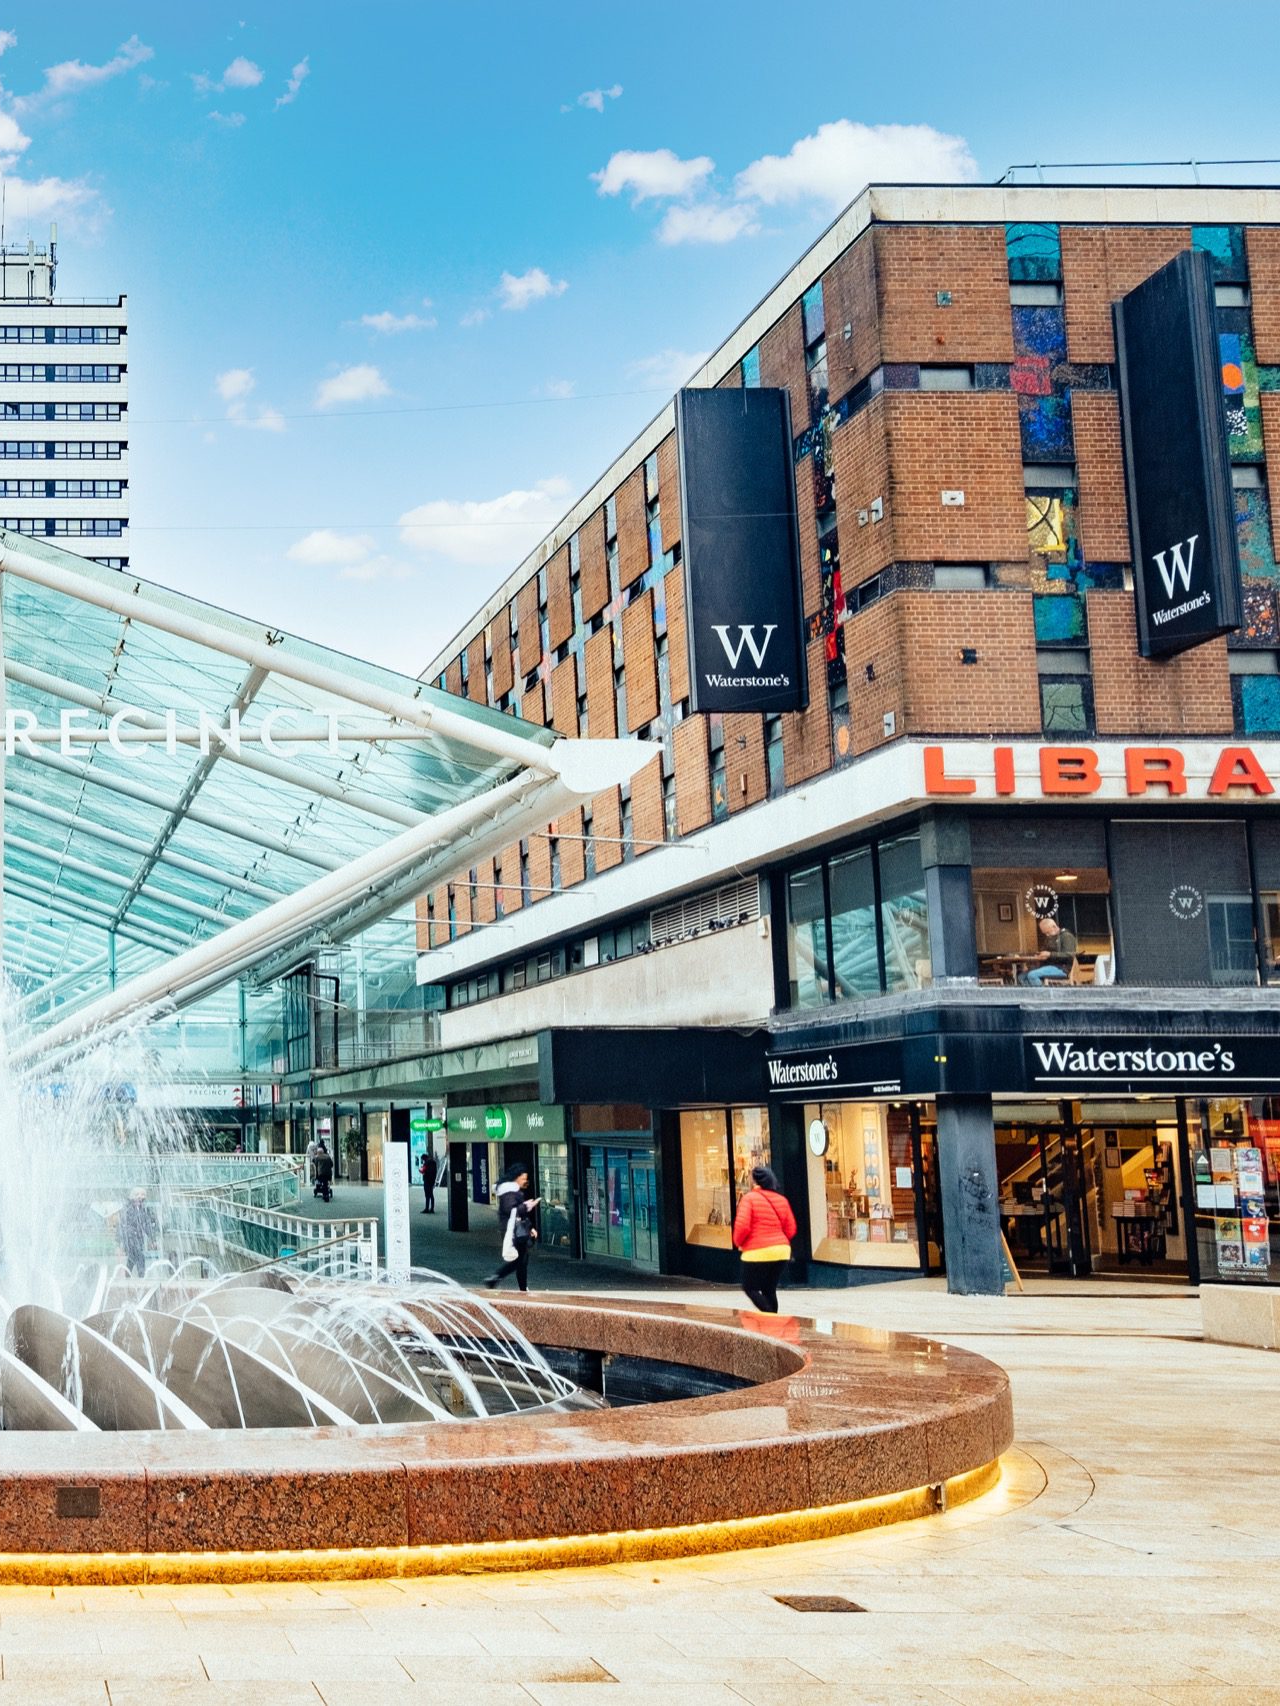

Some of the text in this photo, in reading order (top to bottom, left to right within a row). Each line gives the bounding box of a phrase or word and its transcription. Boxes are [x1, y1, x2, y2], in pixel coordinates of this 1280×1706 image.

[1152, 534, 1199, 599] W
[1152, 590, 1211, 626] Waterstone's
[711, 624, 778, 669] W
[705, 674, 790, 687] Waterstone's
[923, 747, 1276, 795] LIBRA
[768, 1054, 838, 1085] Waterstone's
[1032, 1042, 1236, 1072] Waterstone's
